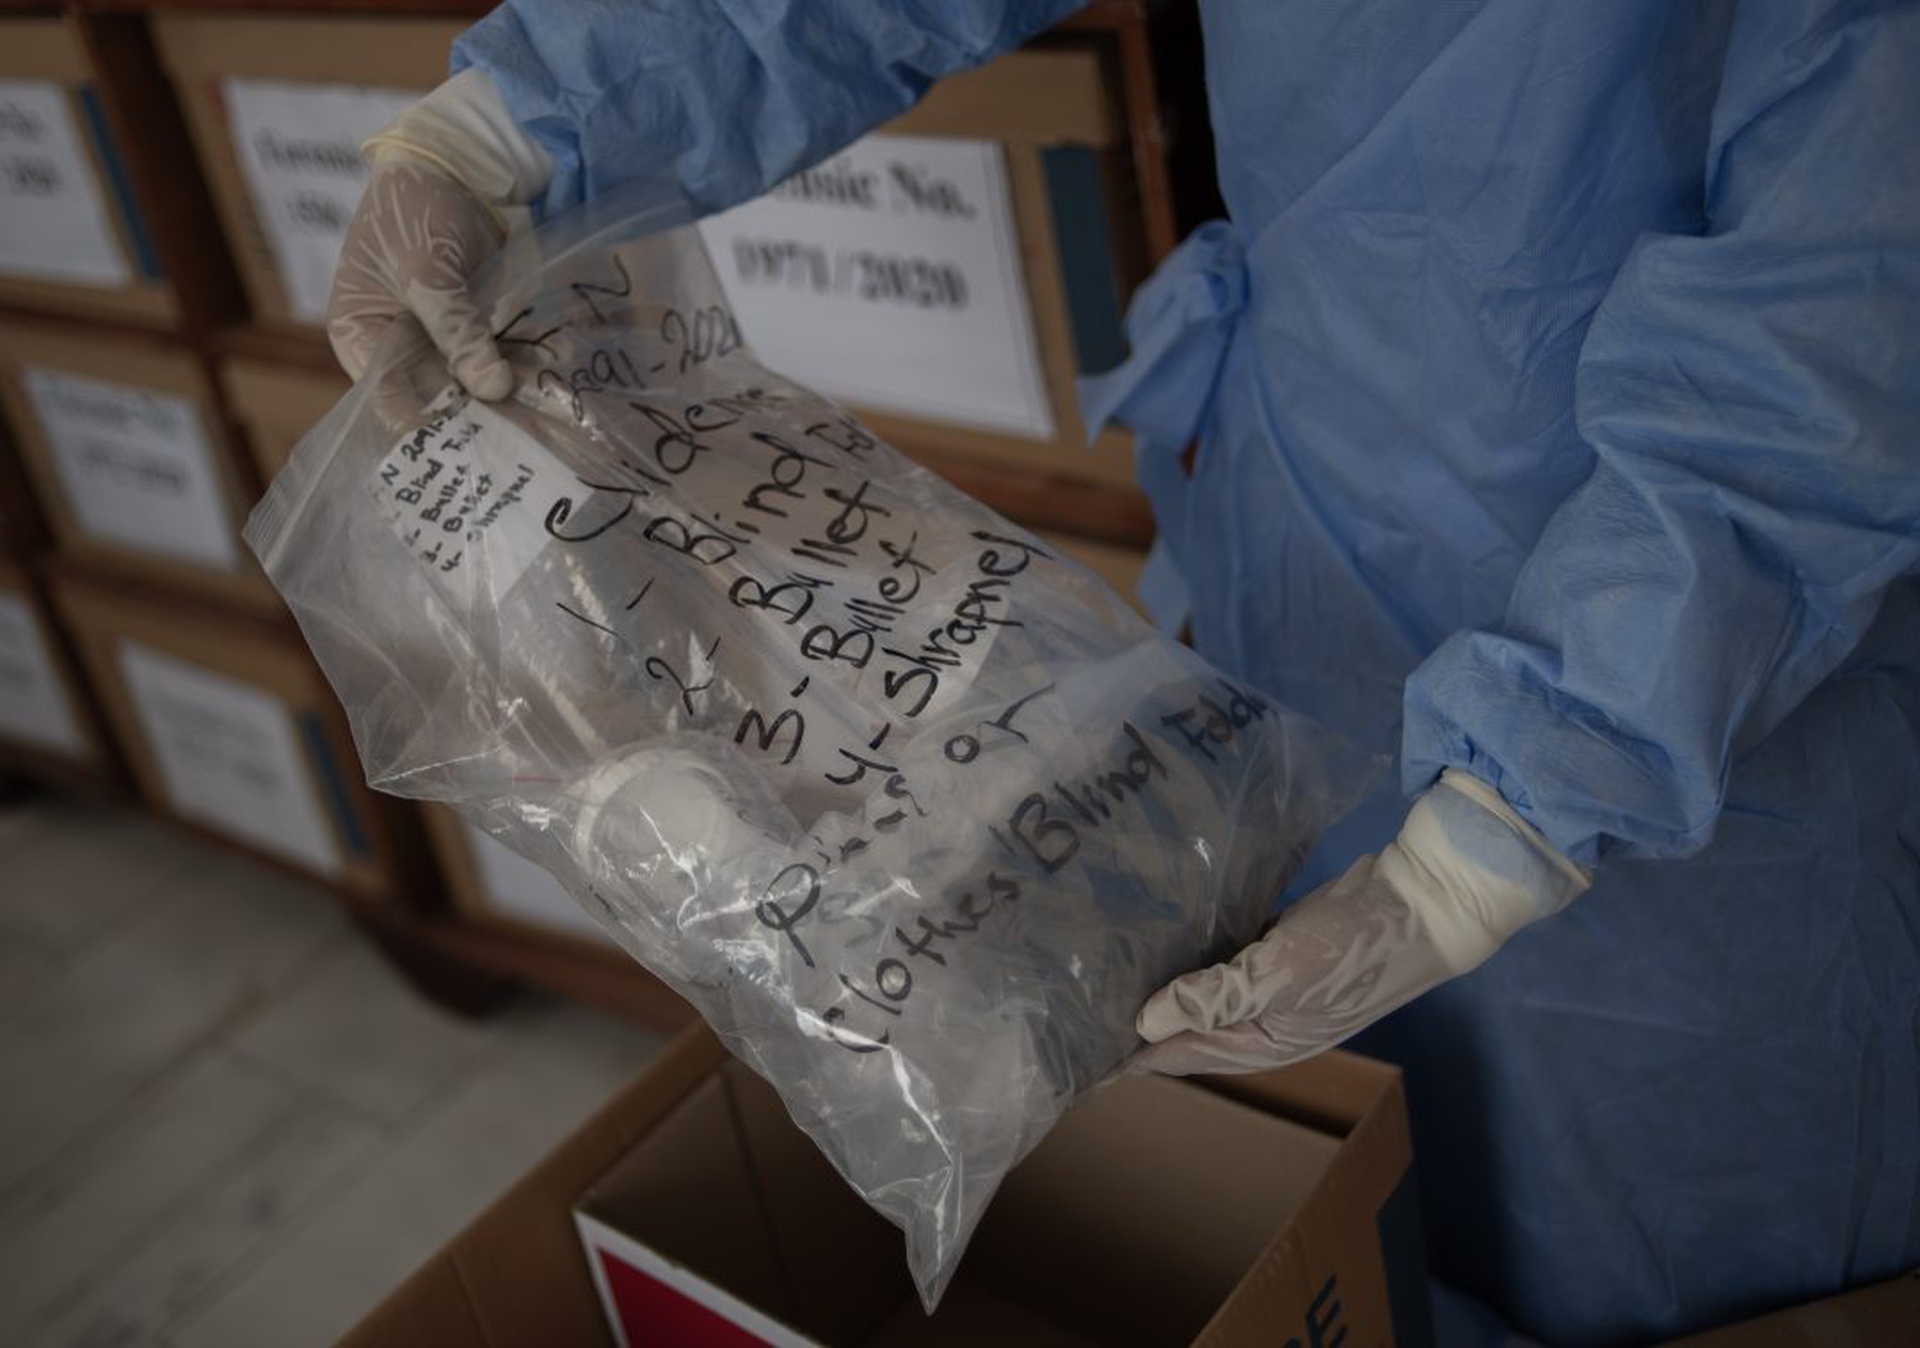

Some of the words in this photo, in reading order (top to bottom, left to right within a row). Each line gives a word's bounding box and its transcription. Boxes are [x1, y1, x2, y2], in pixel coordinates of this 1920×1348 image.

[643, 430, 840, 566] Blind
[729, 480, 892, 625] Bullet
[800, 531, 937, 668] Bullet
[884, 530, 1053, 718] Shrapnel
